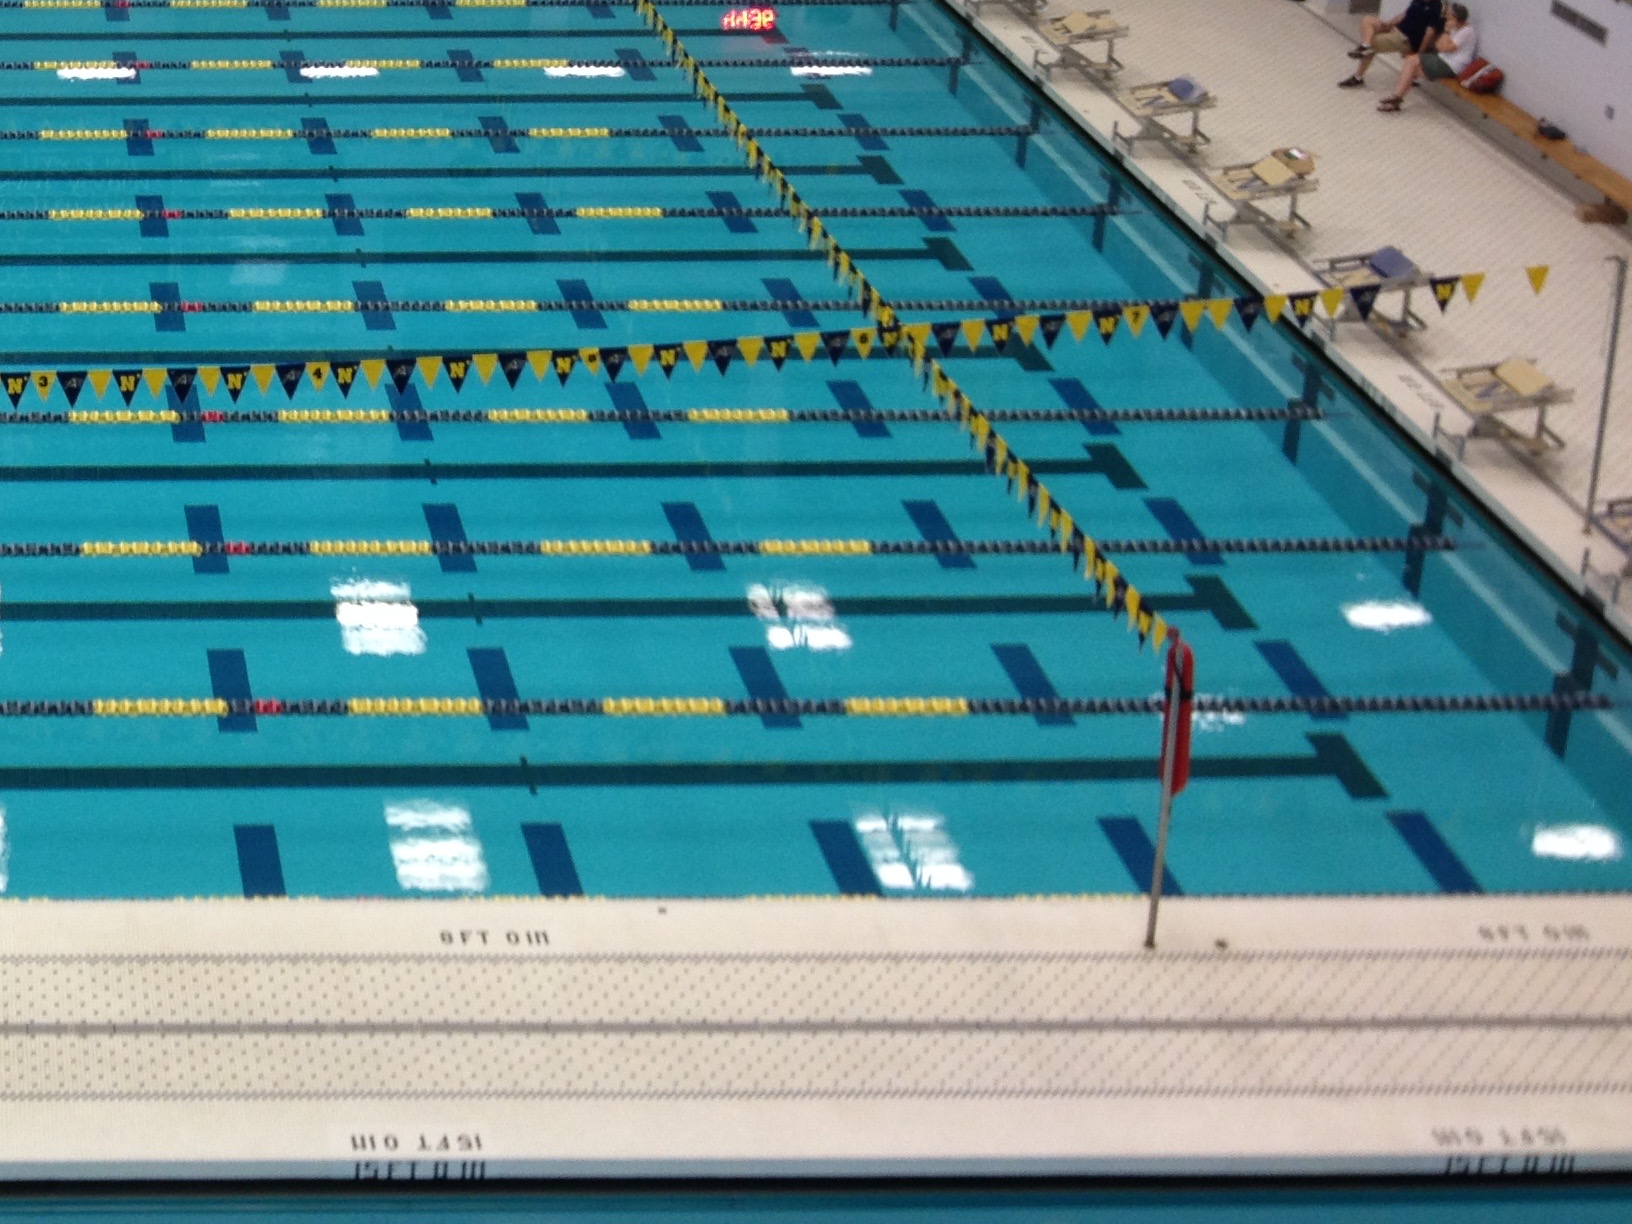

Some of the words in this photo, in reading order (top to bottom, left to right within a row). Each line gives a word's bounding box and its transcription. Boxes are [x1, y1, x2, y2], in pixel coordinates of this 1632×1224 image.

[1436, 285, 1454, 301] N
[1295, 298, 1313, 315] N
[992, 324, 1008, 341] N
[1099, 317, 1115, 334] N
[771, 340, 787, 357] N
[556, 357, 571, 373] N
[660, 349, 675, 365] N
[338, 367, 353, 383] N
[450, 362, 465, 378] N
[8, 378, 23, 394] N
[39, 376, 48, 388] 3
[120, 375, 135, 391] N
[227, 373, 242, 390] N
